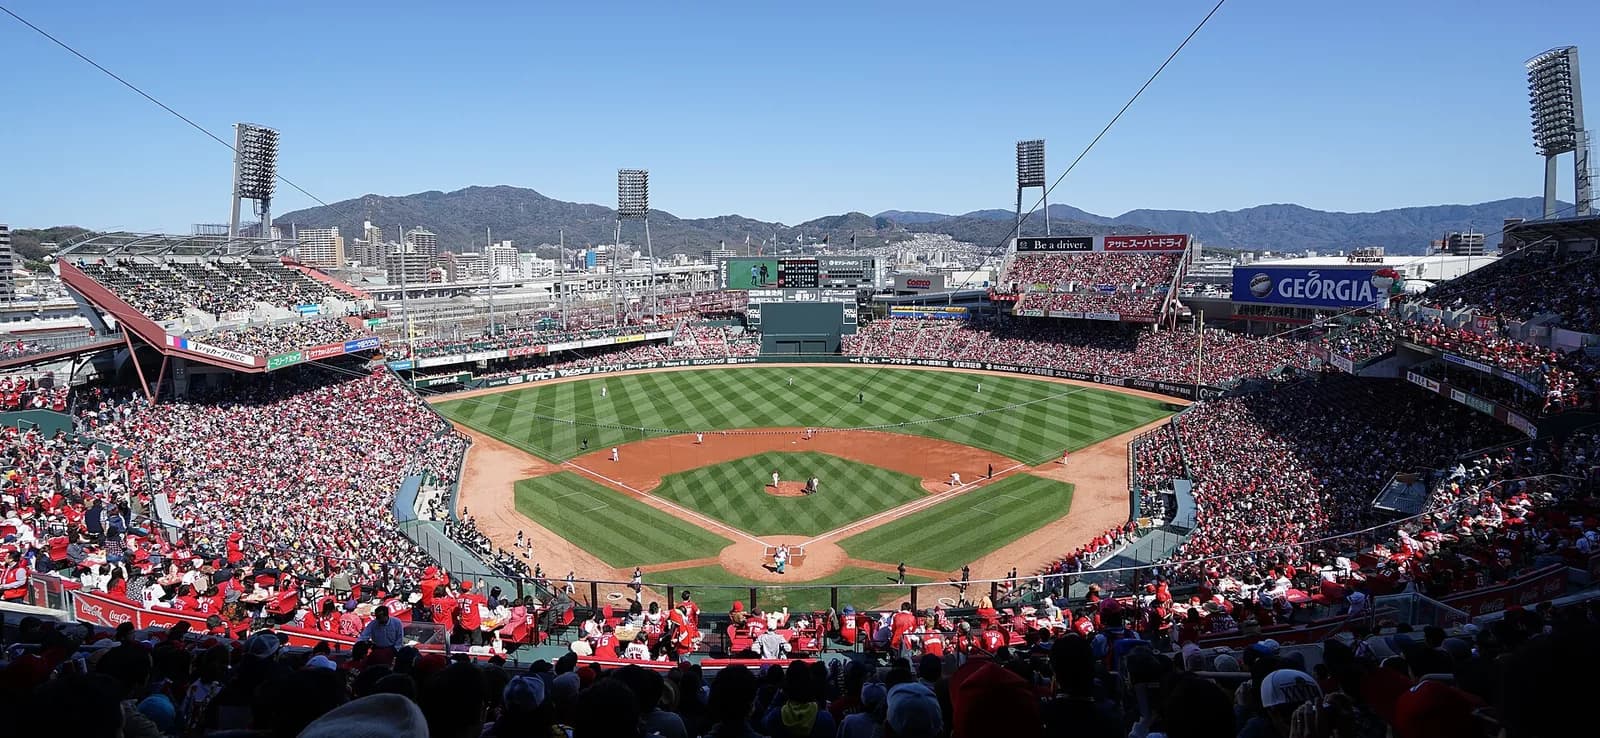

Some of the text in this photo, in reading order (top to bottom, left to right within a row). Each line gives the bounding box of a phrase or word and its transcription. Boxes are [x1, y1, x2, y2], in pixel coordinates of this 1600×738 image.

[1034, 240, 1048, 250] Be
[1056, 239, 1087, 250] driver.
[1107, 238, 1183, 249] アサヒスーパードライ
[1277, 271, 1374, 302] GEORGIA
[993, 364, 1019, 372] SUZUKI
